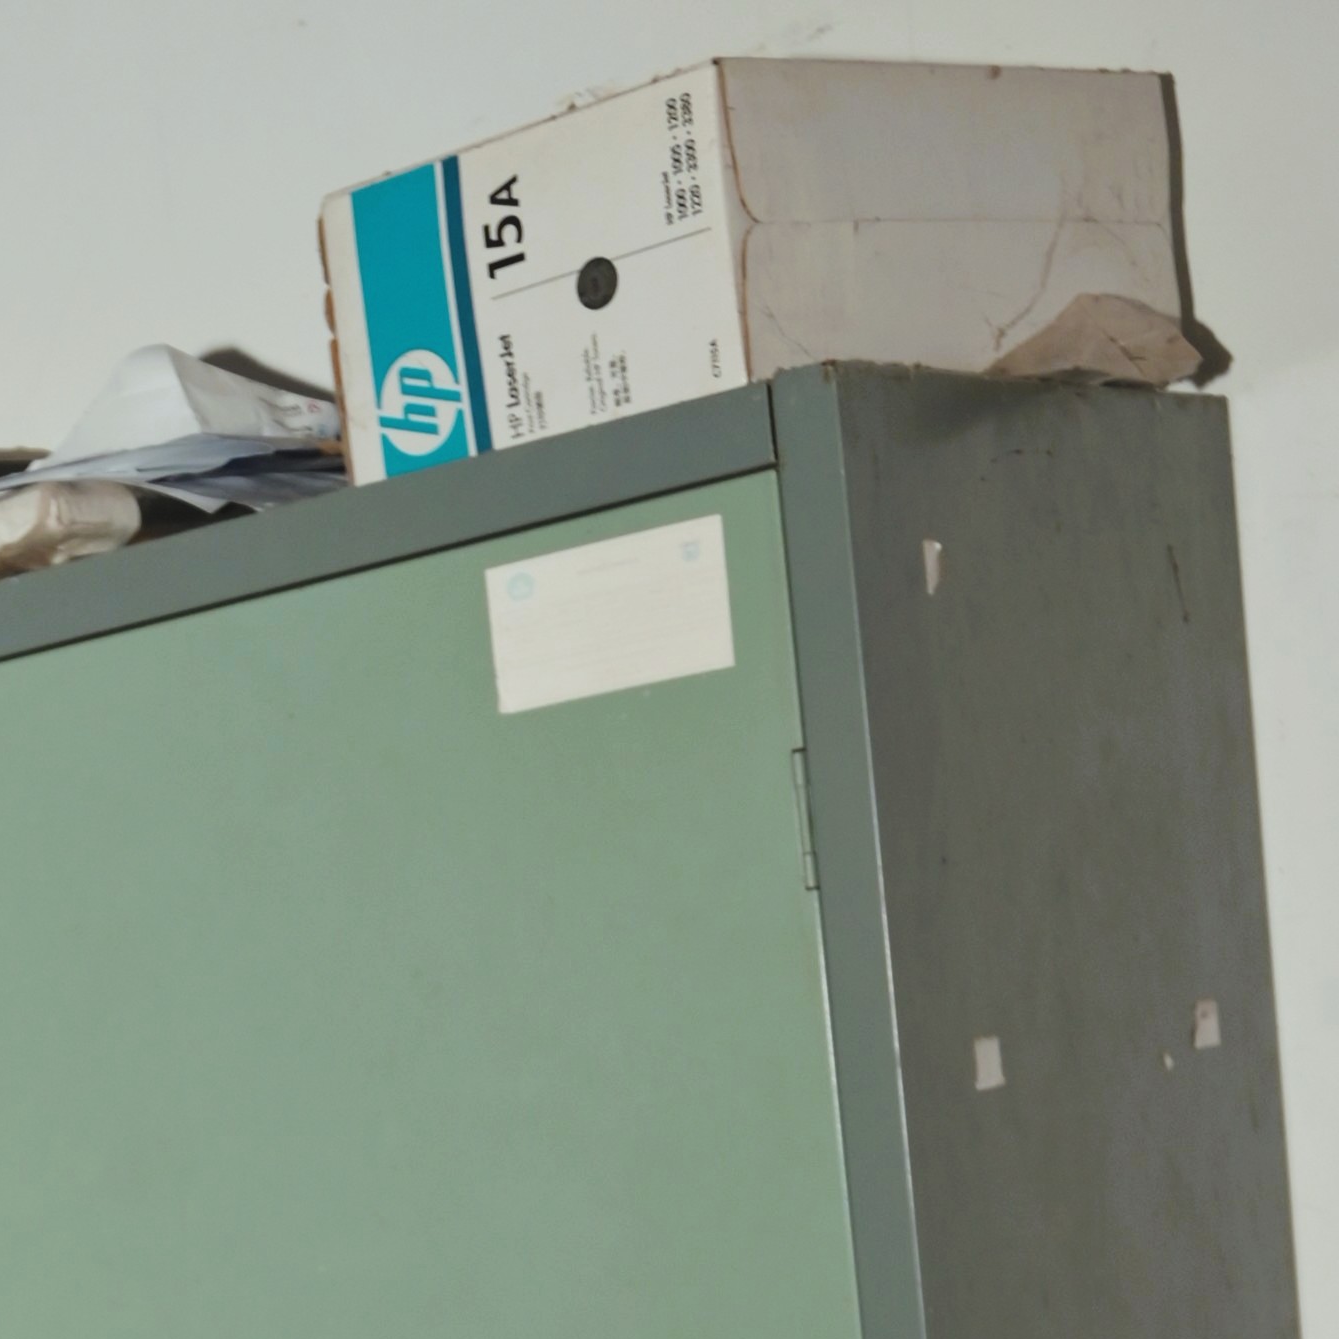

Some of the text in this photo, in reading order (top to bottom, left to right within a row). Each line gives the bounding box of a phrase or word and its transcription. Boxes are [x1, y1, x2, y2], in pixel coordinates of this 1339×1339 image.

[483, 174, 526, 280] 15A
[379, 367, 462, 435] hp
[497, 334, 525, 439] HP LaserJet
